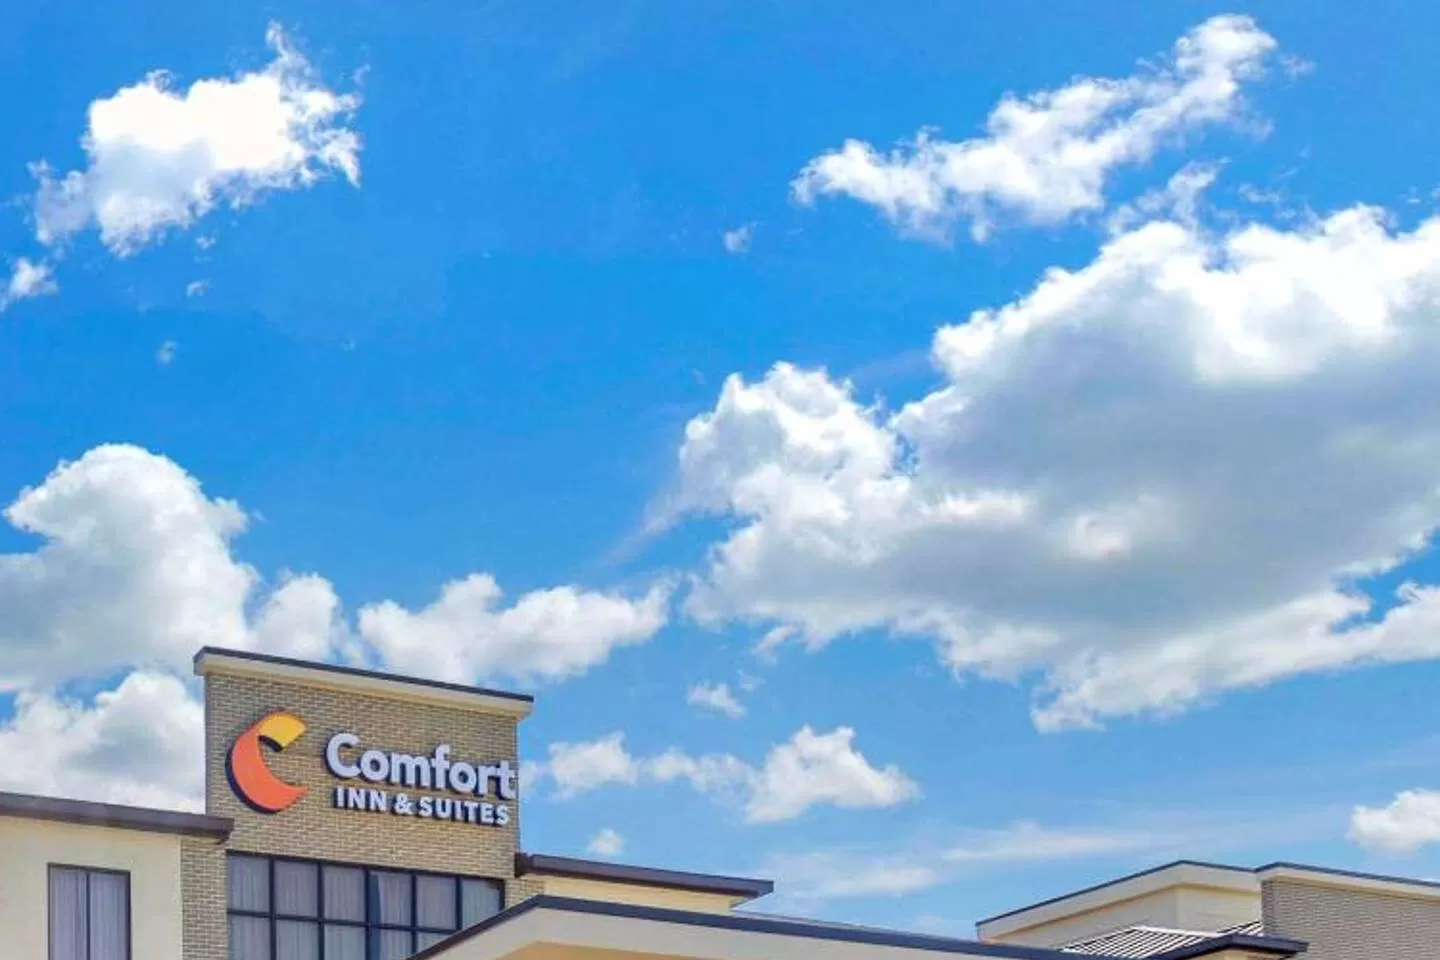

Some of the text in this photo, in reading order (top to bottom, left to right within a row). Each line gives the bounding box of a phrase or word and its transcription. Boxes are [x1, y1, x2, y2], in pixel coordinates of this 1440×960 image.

[324, 732, 516, 799] Comfort
[335, 786, 511, 826] INN & SUITES
